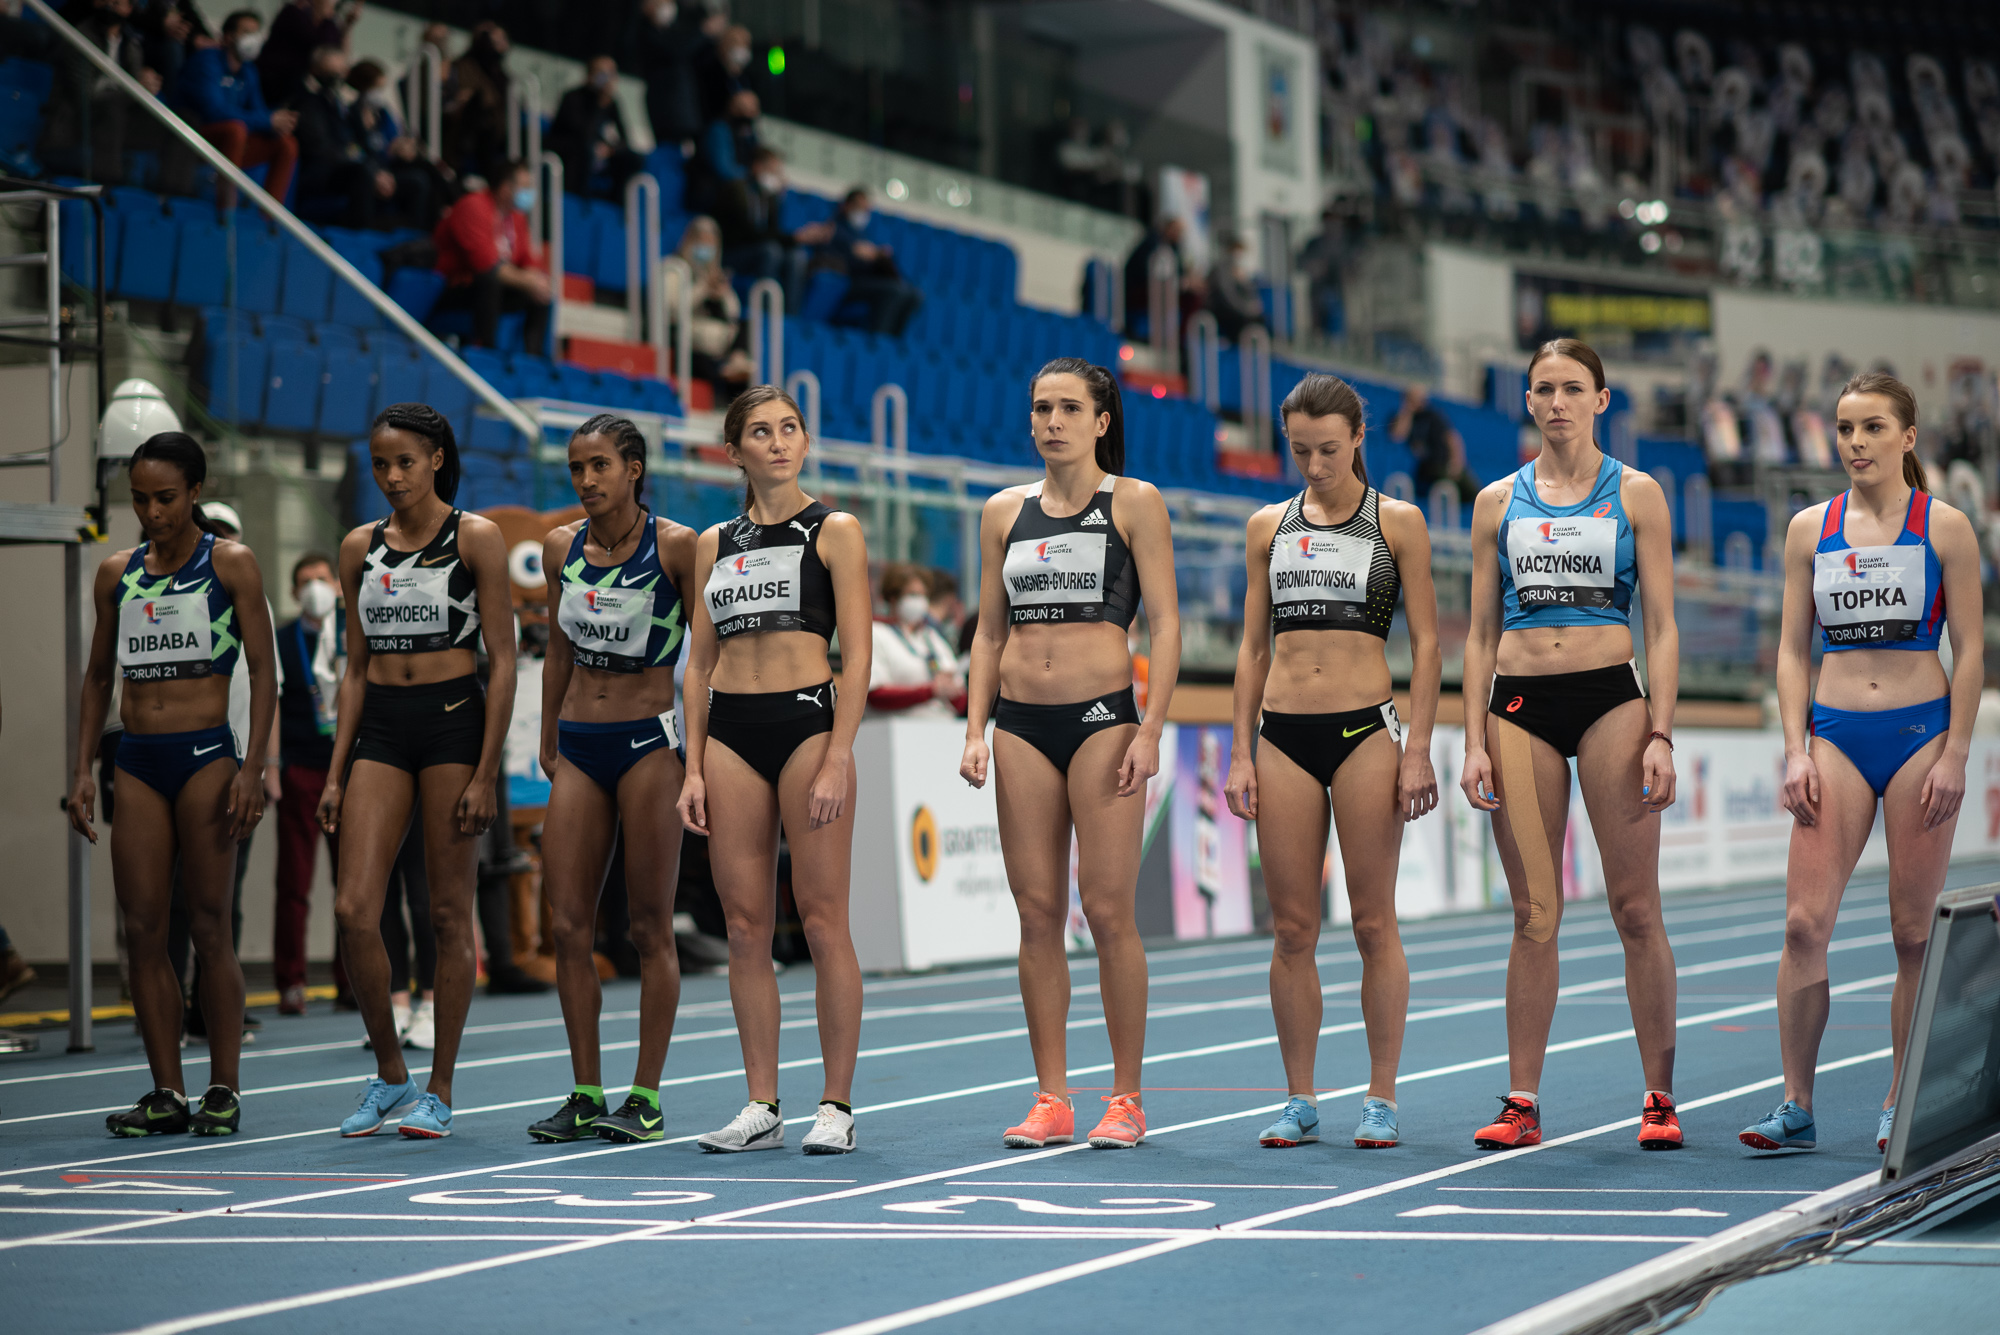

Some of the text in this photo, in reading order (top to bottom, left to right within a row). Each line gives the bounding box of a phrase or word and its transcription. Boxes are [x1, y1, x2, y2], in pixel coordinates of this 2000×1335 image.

[1080, 518, 1108, 527] adidas
[744, 560, 771, 568] POMORZE
[745, 556, 767, 564] KUJAWY
[1516, 551, 1603, 576] KACZYŃSKA
[1858, 556, 1884, 564] KUJAWY
[1010, 572, 1097, 593] WAGNER-GYURKES
[1276, 570, 1356, 590] BRONIATOWSKA
[711, 580, 790, 610] KRAUSE
[1559, 591, 1575, 602] 21
[1829, 587, 1907, 612] TOPKA
[596, 601, 622, 609] POMORZE
[1014, 606, 1048, 621] TORUŃ
[1051, 607, 1064, 619] 21
[1277, 602, 1309, 619] TORUŃ
[1311, 604, 1326, 616] 21
[366, 604, 439, 624] CHEPKOECH
[575, 621, 630, 642] HAILU
[719, 616, 761, 636] TORUŃ 21
[1829, 624, 1884, 641] TORUŃ 21
[128, 631, 199, 654] DIBABA
[370, 636, 413, 650] TORUŃ 21
[596, 656, 608, 667] 21
[163, 666, 177, 677] 21
[1082, 713, 1116, 722] adidas
[1389, 704, 1400, 736] 3
[408, 1188, 716, 1206] 3
[882, 1195, 1216, 1215] 2
[1395, 1204, 1731, 1217] 1
